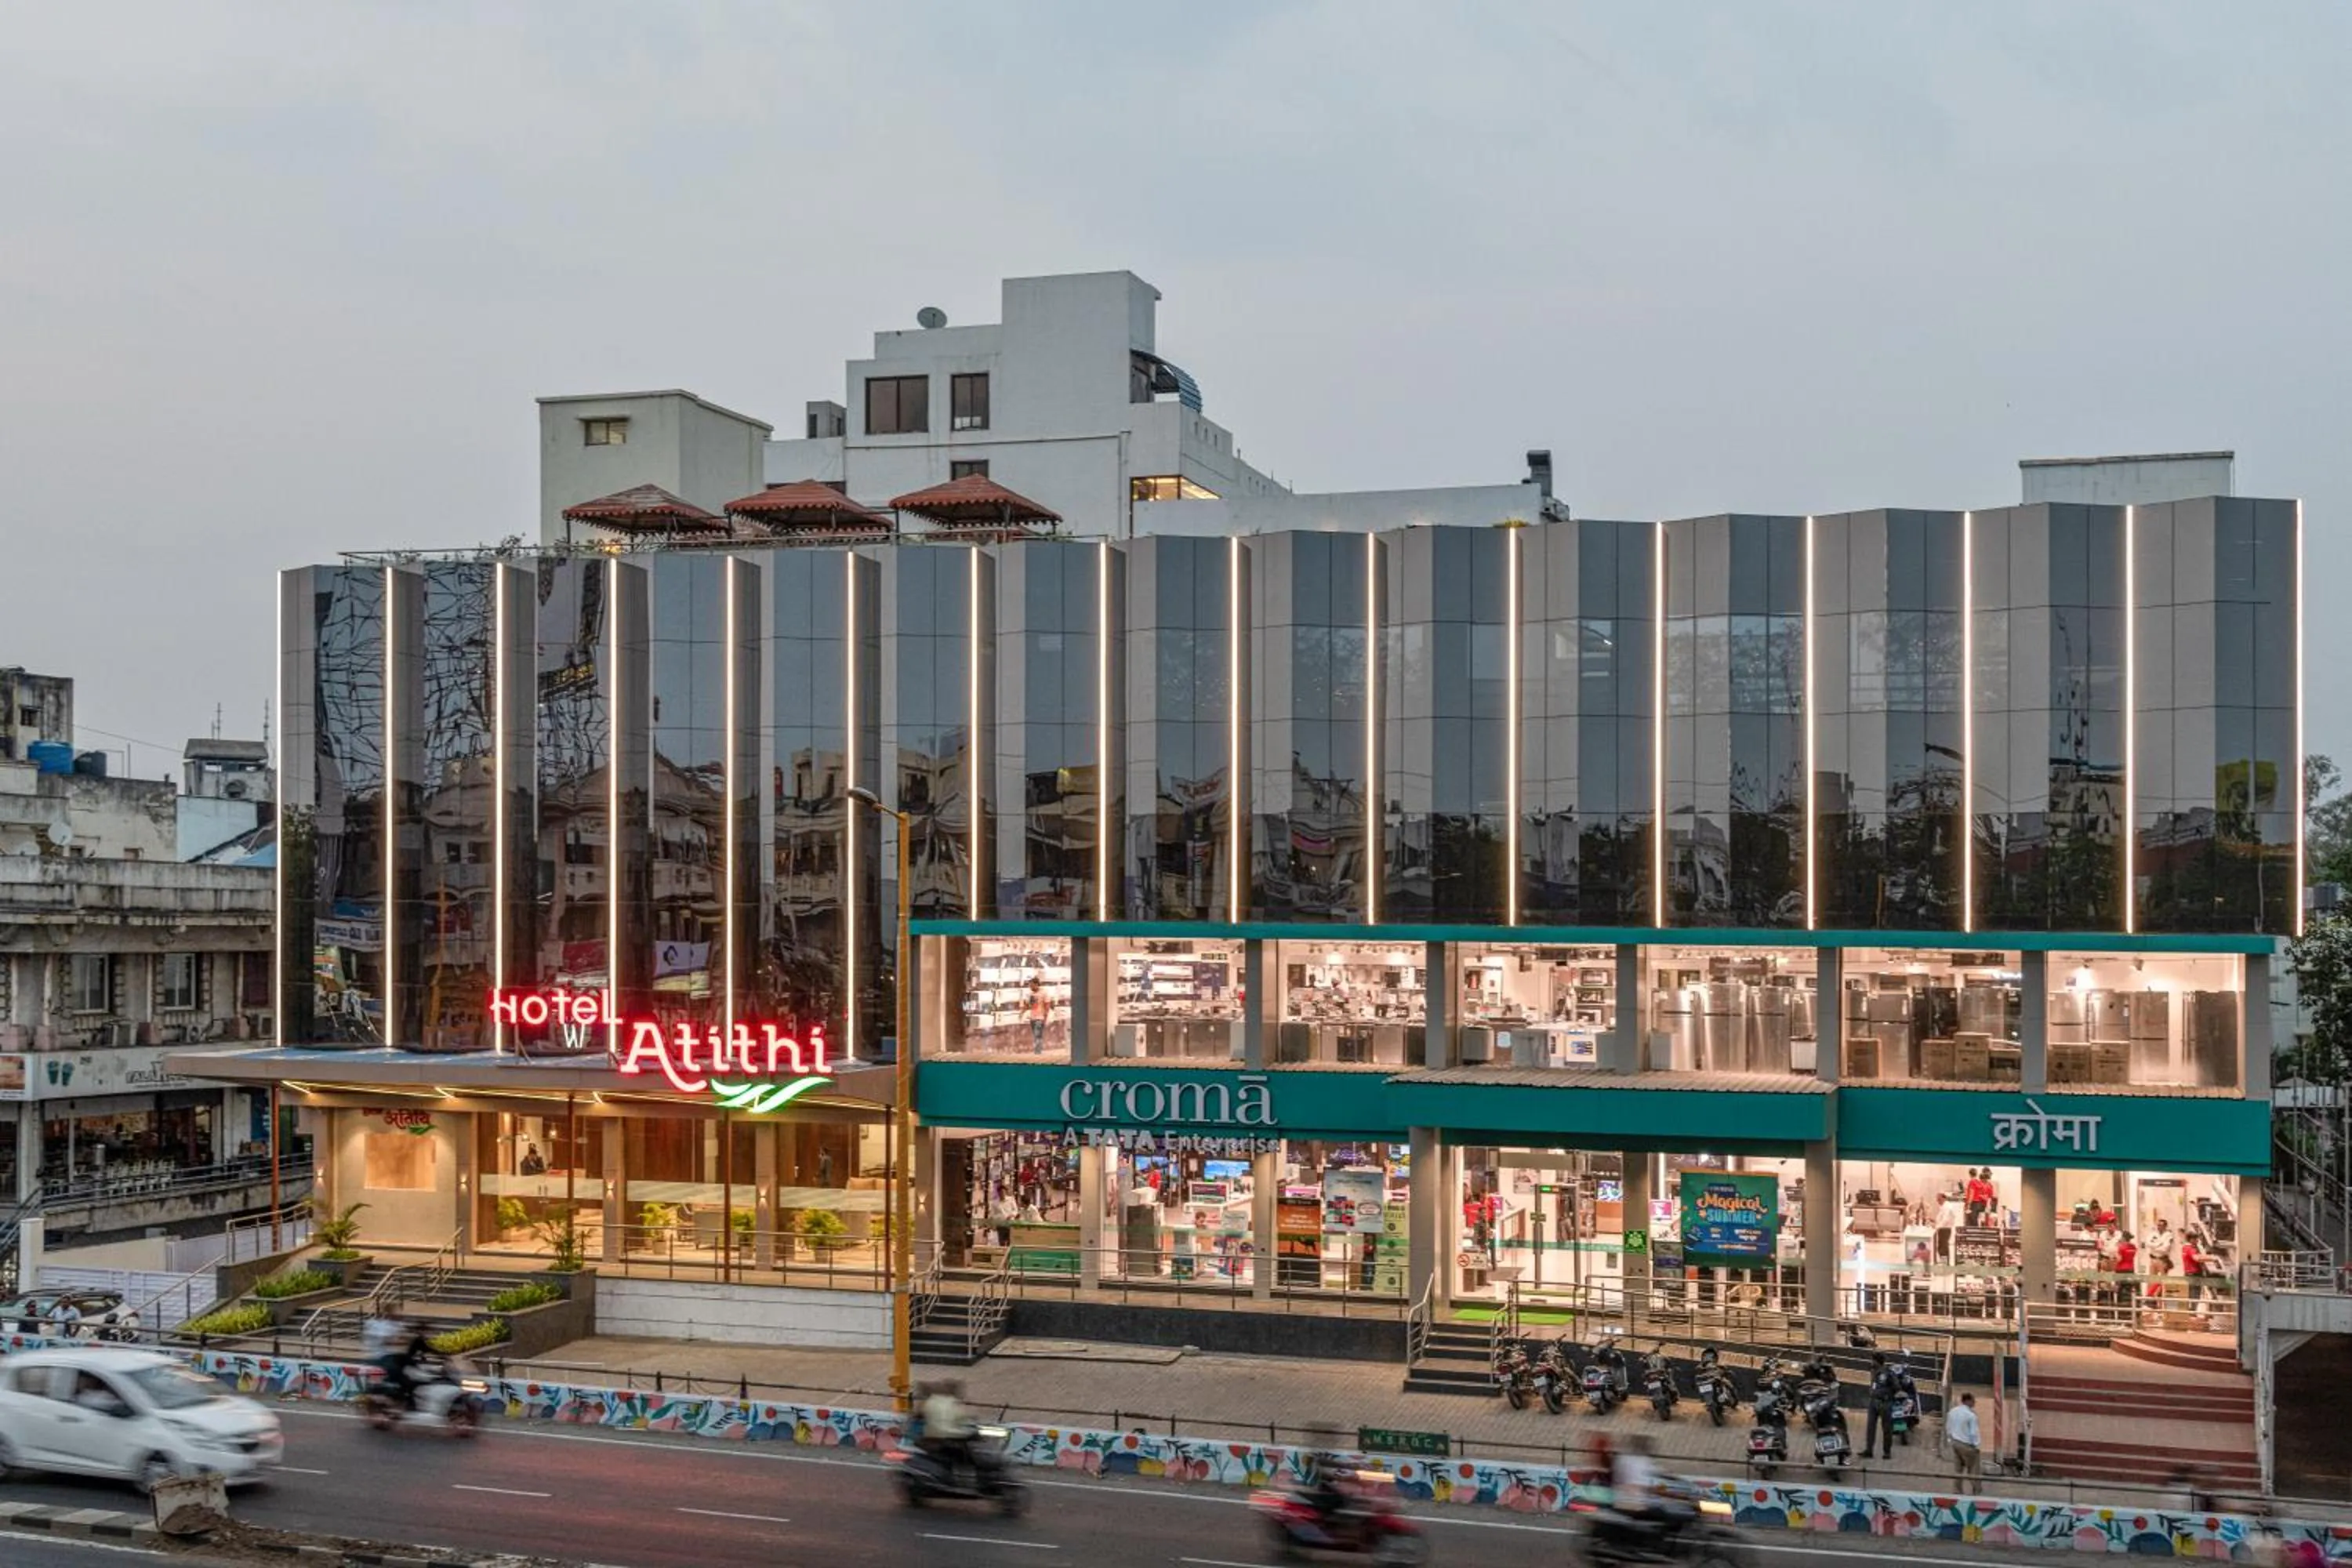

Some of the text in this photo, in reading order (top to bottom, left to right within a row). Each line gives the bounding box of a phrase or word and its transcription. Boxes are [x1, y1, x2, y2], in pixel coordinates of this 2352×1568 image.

[620, 1022, 833, 1092] Atithi
[1991, 1098, 2102, 1152] क्रोमा
[1062, 1127, 1280, 1157] A TATA Enterprise
[1697, 1192, 1768, 1213] Magical
[1707, 1208, 1756, 1225] SUMMER
